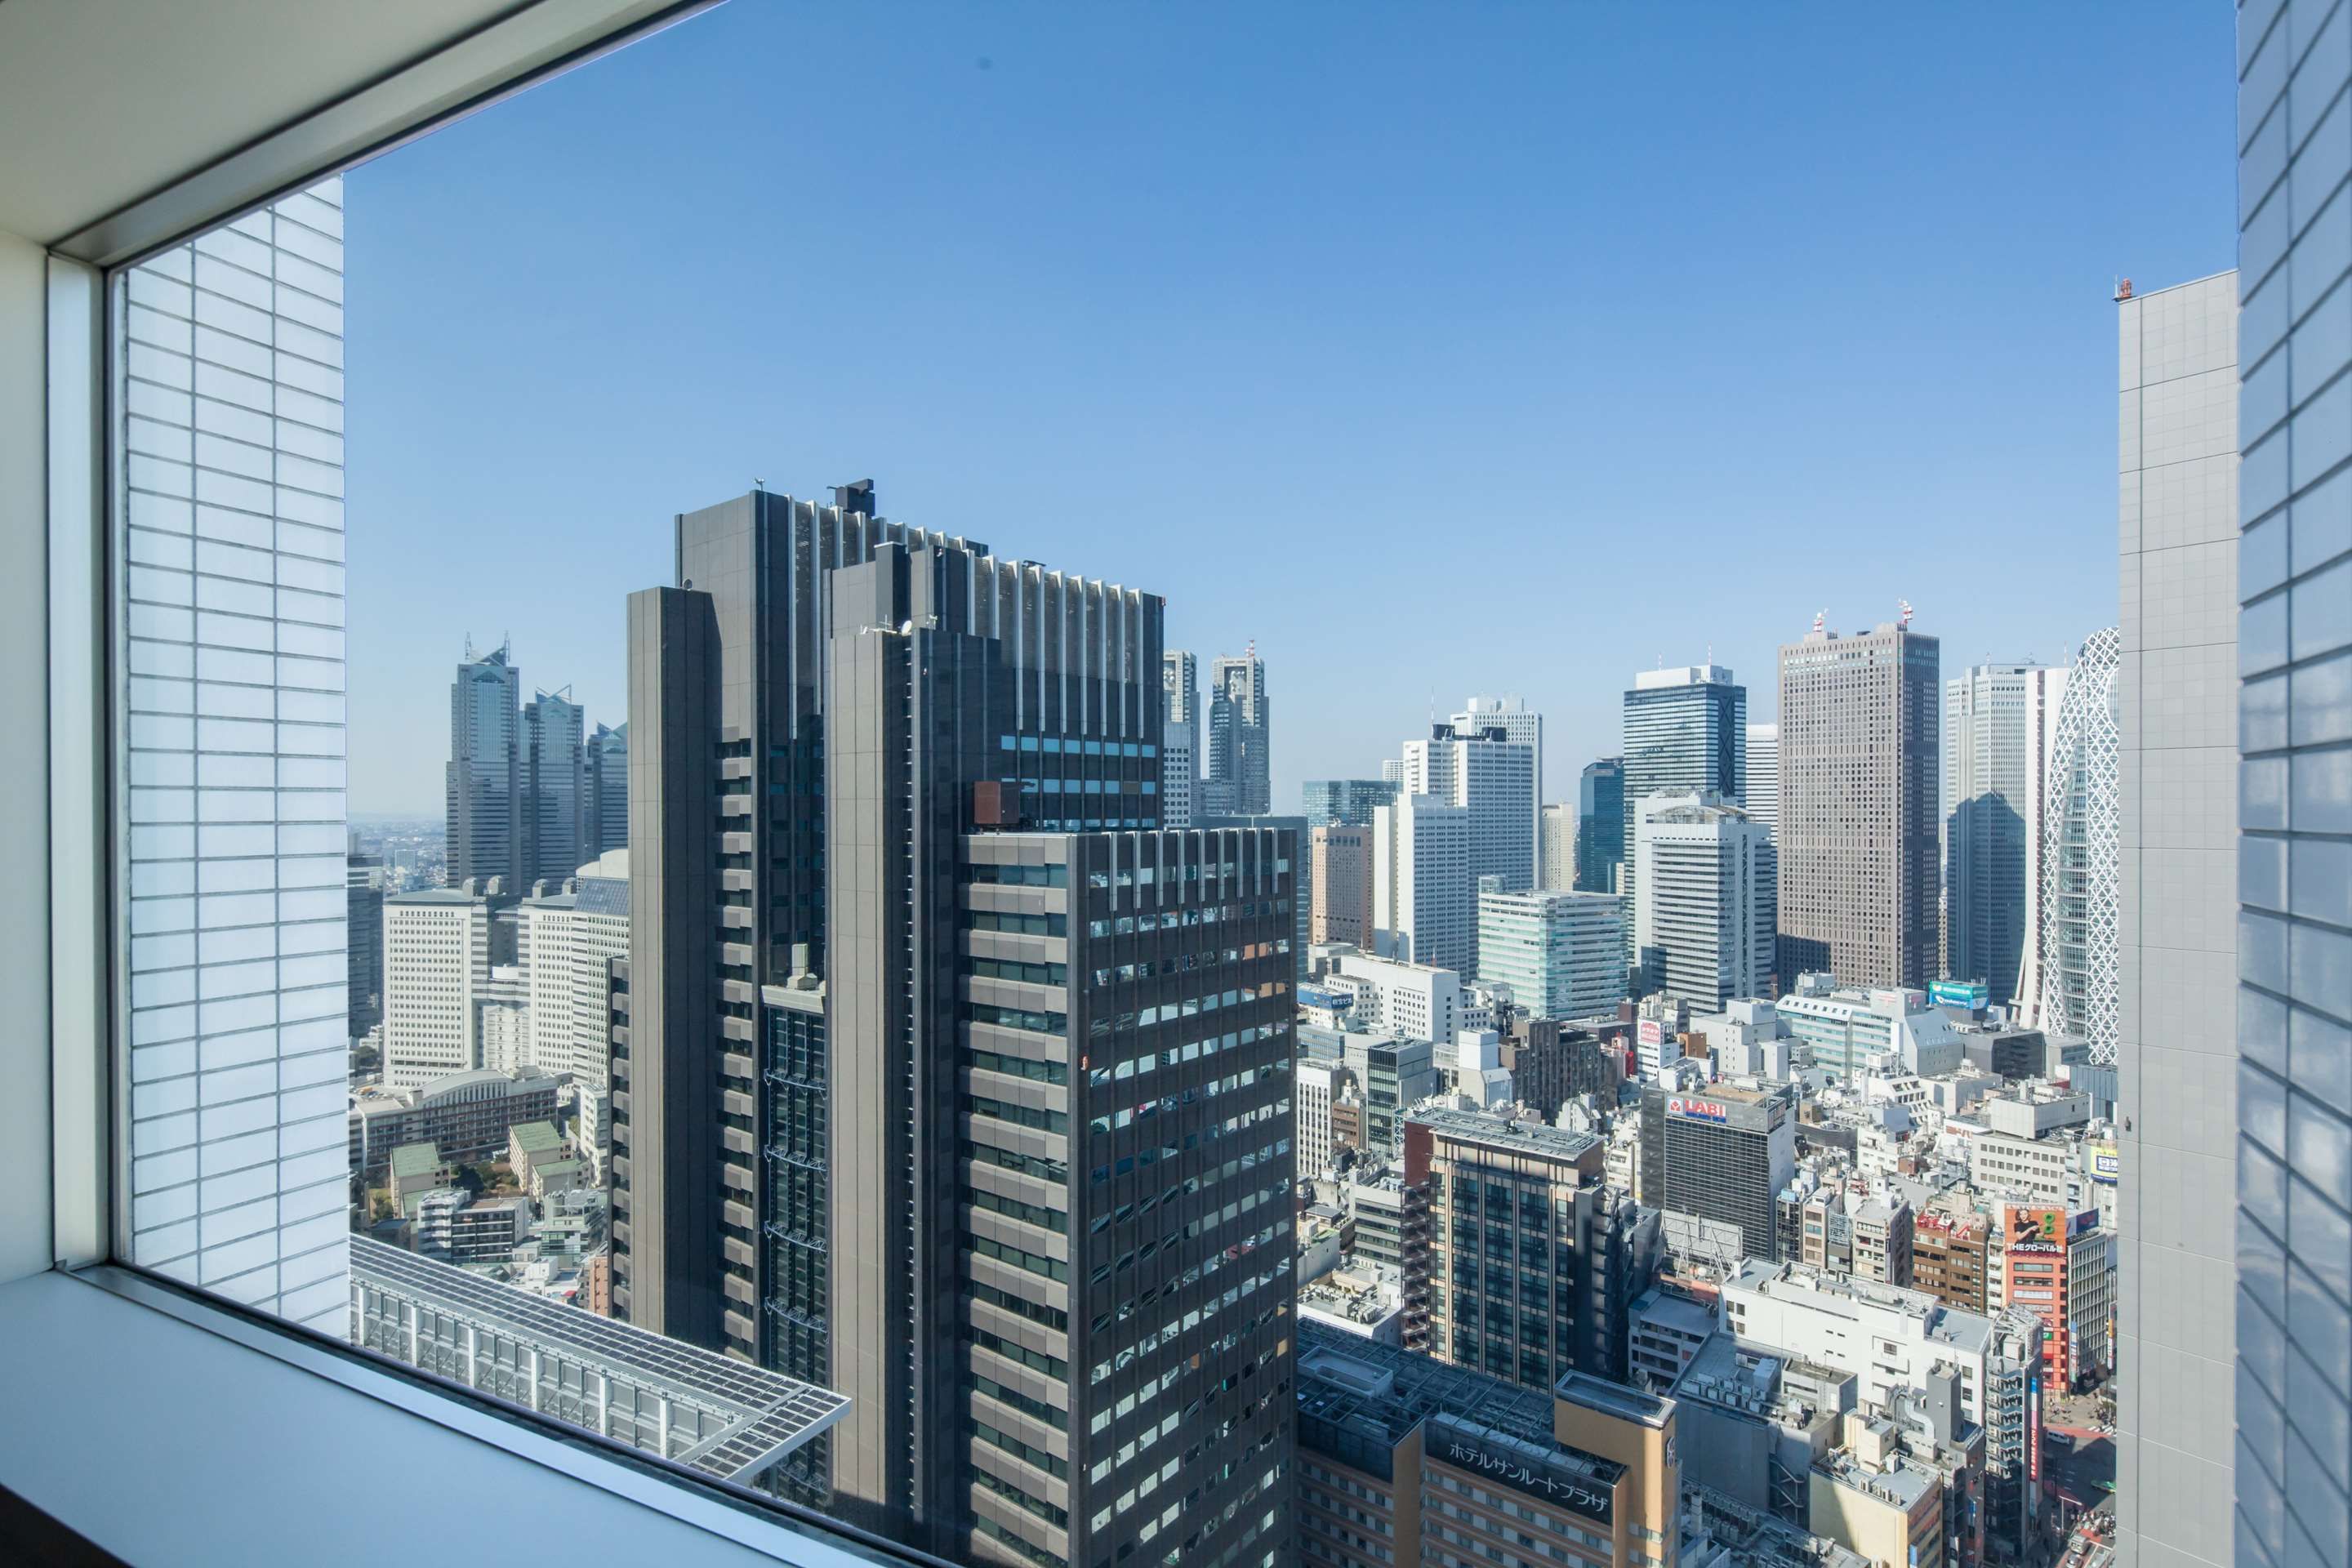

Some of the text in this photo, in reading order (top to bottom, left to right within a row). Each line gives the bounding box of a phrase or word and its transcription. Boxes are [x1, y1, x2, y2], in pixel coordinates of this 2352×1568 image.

[1685, 1099, 1726, 1117] LABI
[2006, 1243, 2064, 1253] THEグローバル社
[1450, 1443, 1609, 1512] ホテルサンルートプラザ
